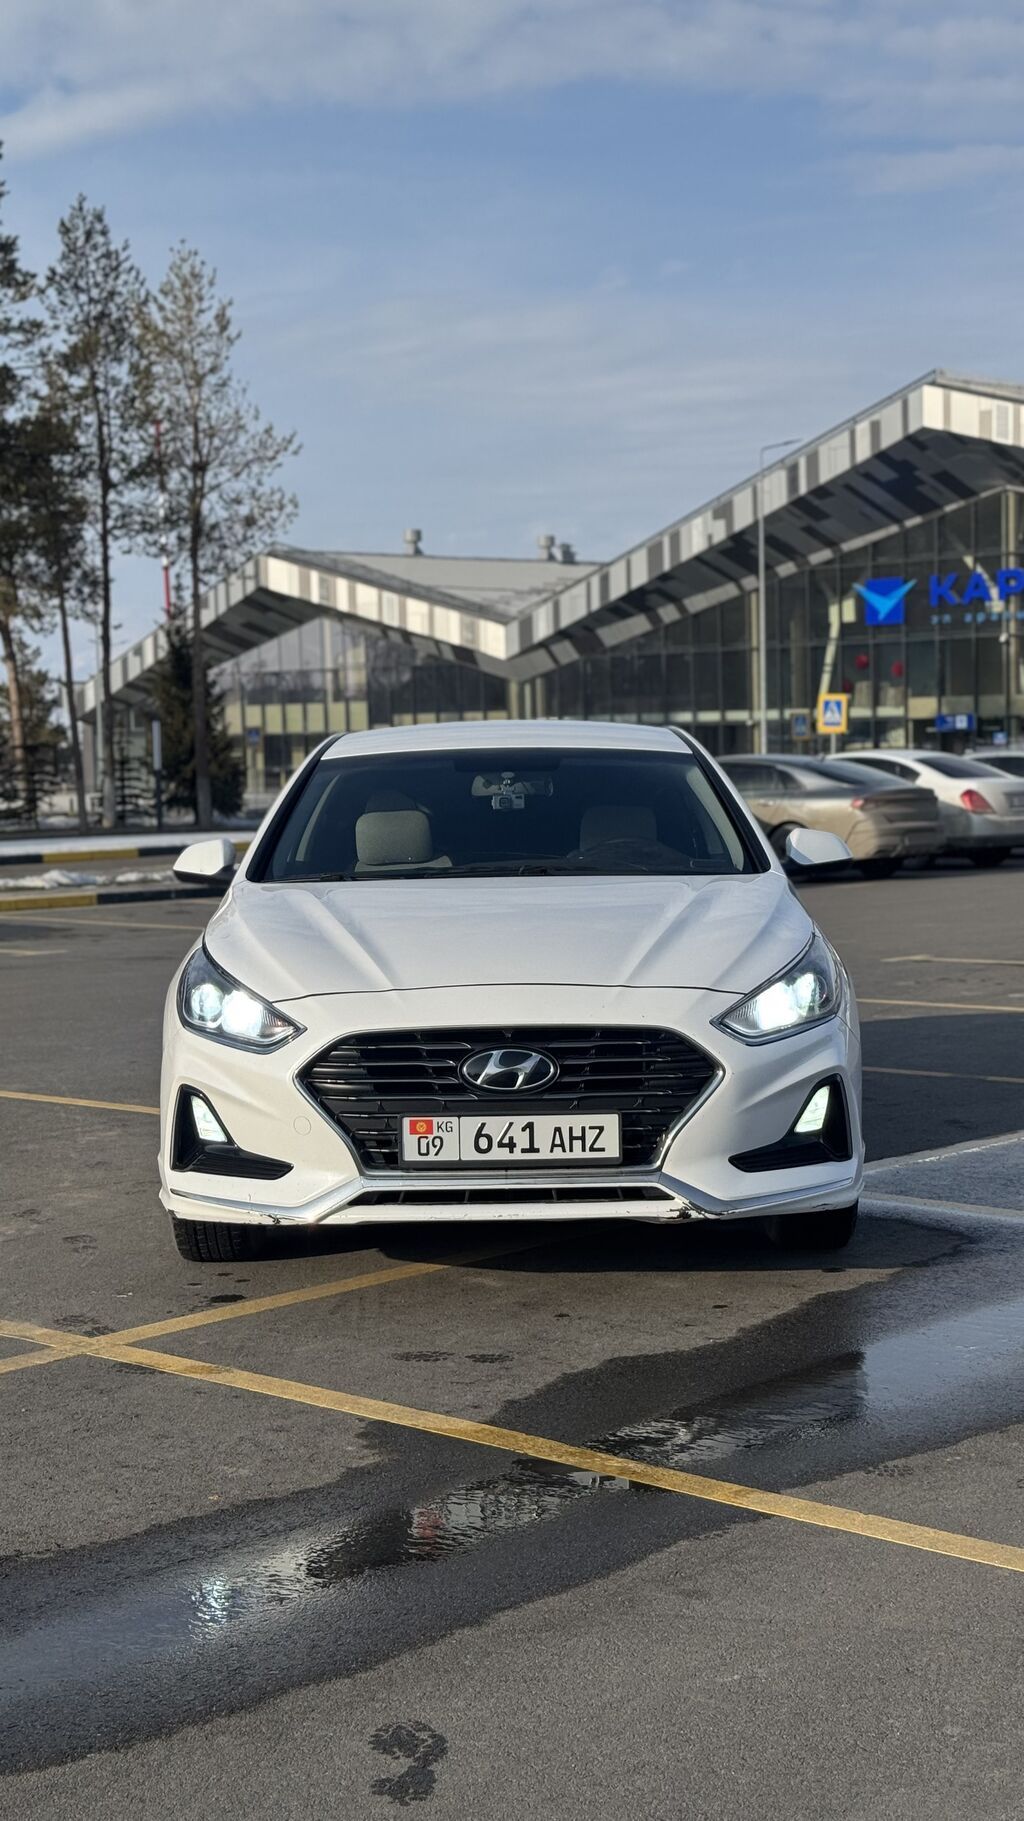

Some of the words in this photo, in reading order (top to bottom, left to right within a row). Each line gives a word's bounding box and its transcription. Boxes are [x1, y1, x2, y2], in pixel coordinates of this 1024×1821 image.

[436, 1120, 453, 1133] KG
[417, 1135, 444, 1156] 09
[473, 1121, 540, 1154] 641
[549, 1125, 606, 1153] AHZ
